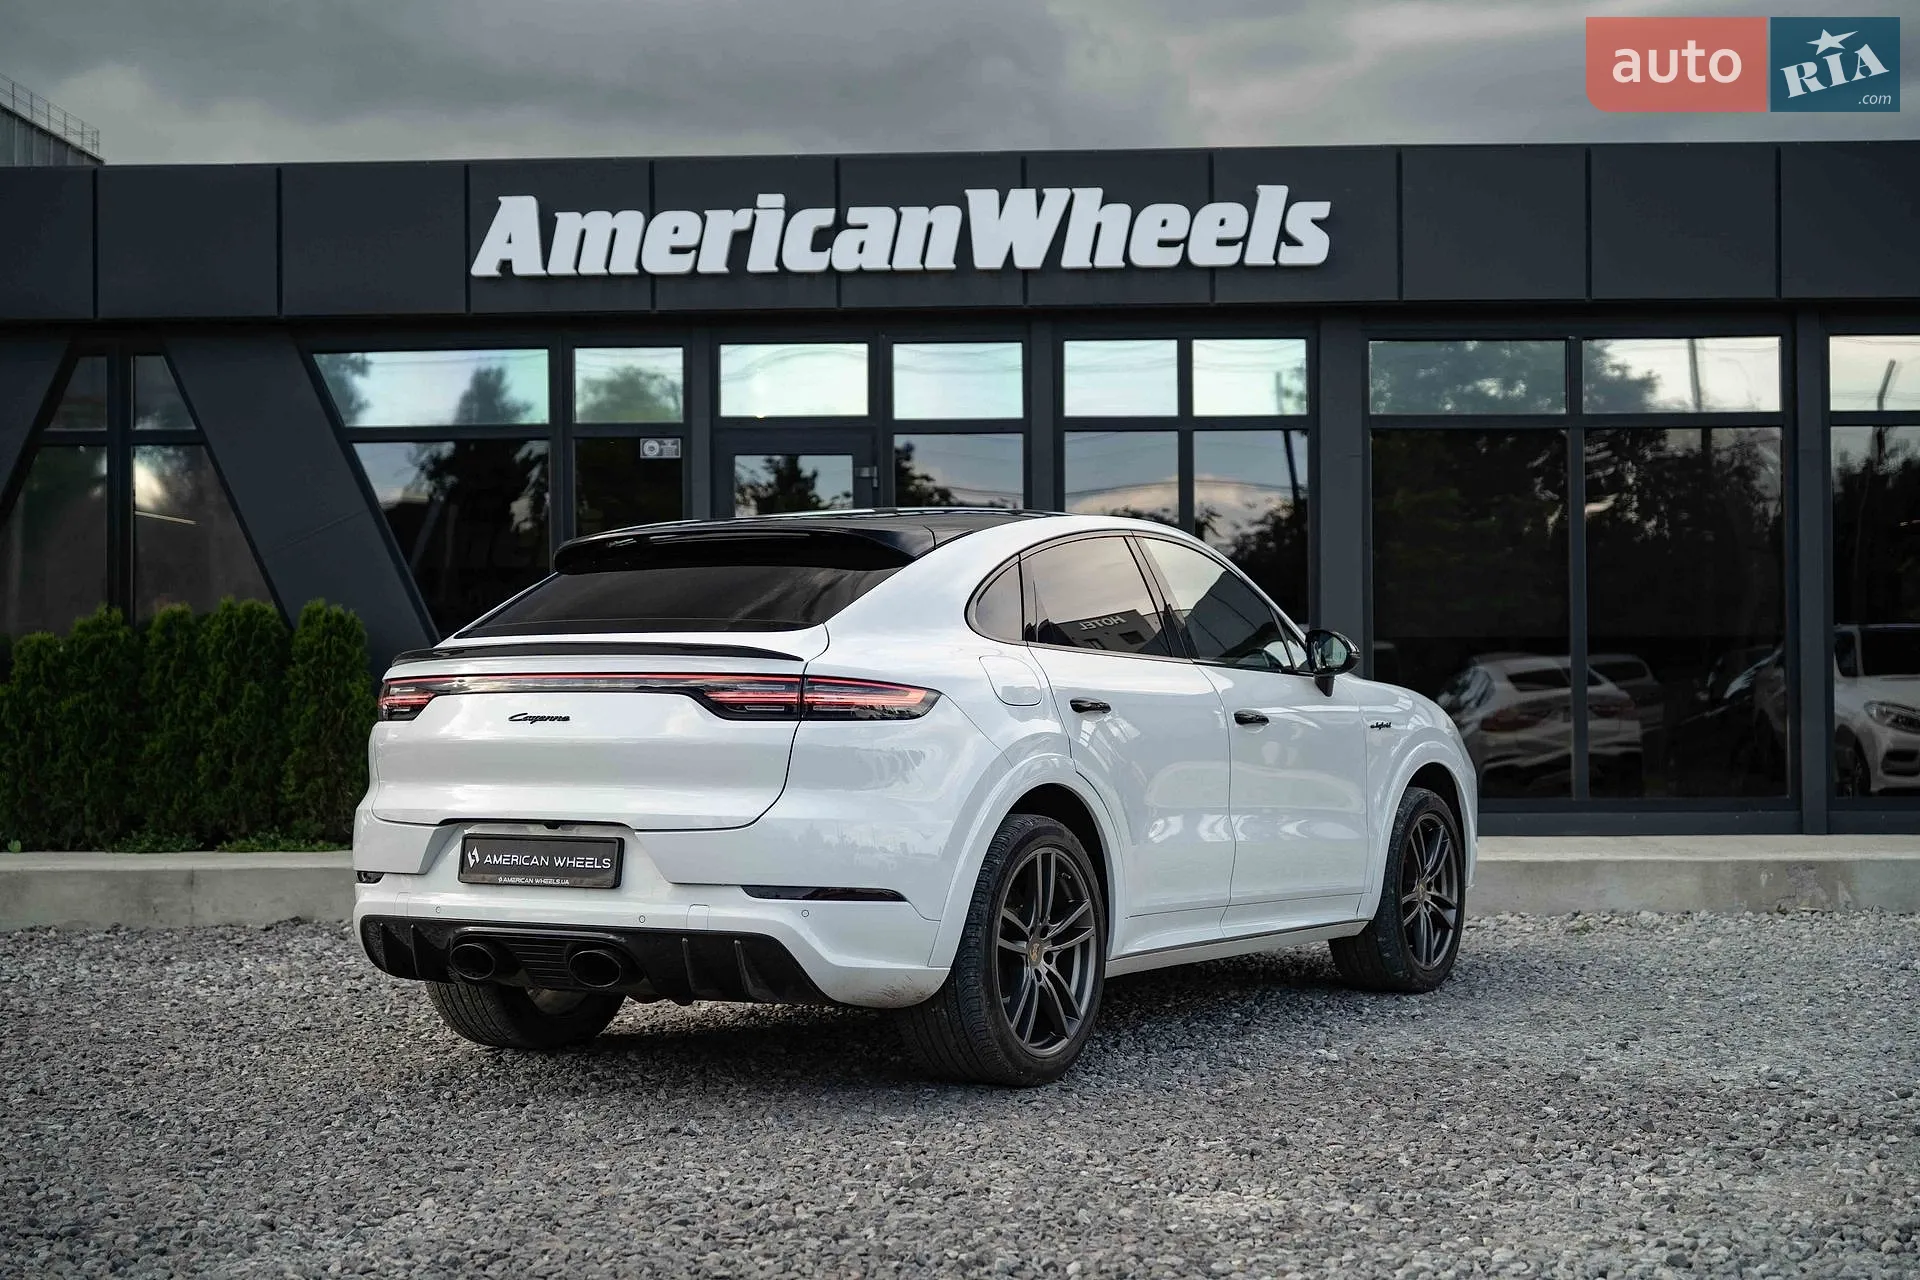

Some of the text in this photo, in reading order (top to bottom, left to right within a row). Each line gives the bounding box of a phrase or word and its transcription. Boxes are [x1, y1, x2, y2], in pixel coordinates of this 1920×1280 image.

[508, 712, 571, 724] Cayenne
[484, 854, 611, 869] AMERICAN WHEELS
